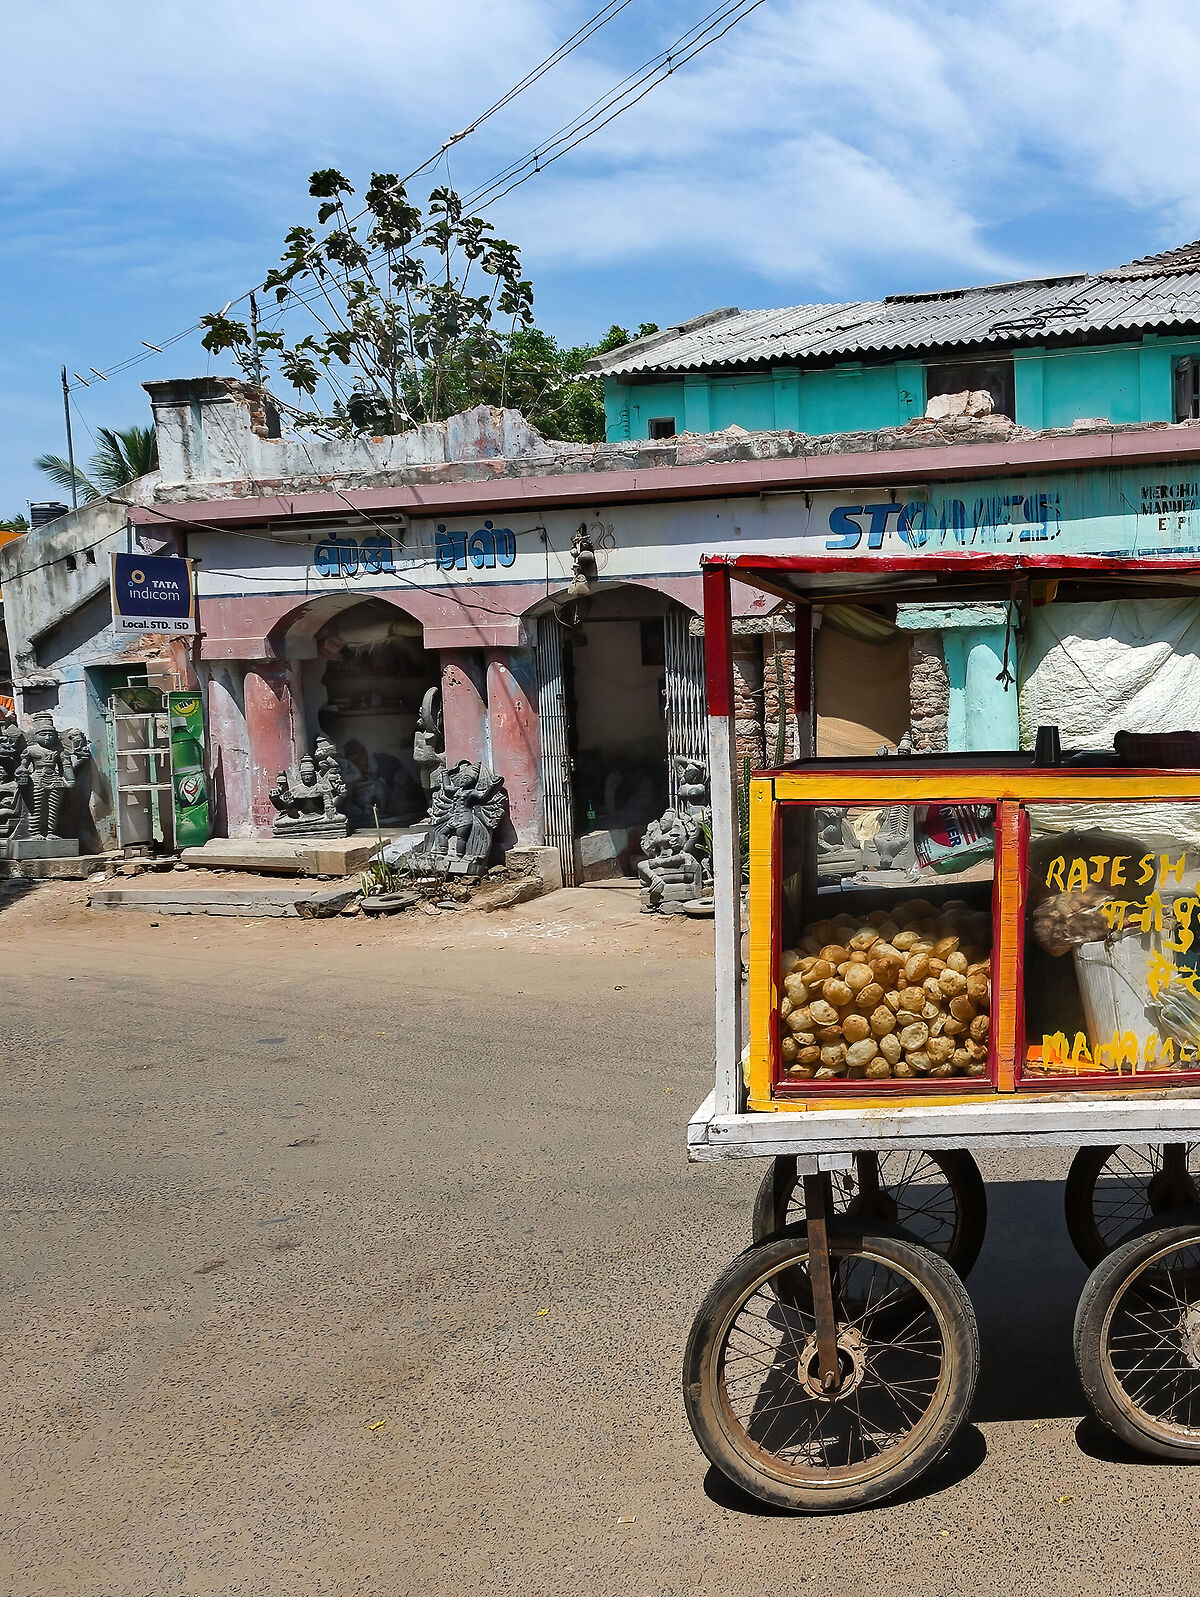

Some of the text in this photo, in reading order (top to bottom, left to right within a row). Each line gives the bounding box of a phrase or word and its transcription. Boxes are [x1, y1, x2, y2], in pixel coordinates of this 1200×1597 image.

[151, 580, 179, 590] TATA
[129, 586, 180, 601] indicom
[150, 620, 171, 629] STD.
[174, 621, 189, 630] ISD
[1046, 851, 1187, 893] RAJESH
